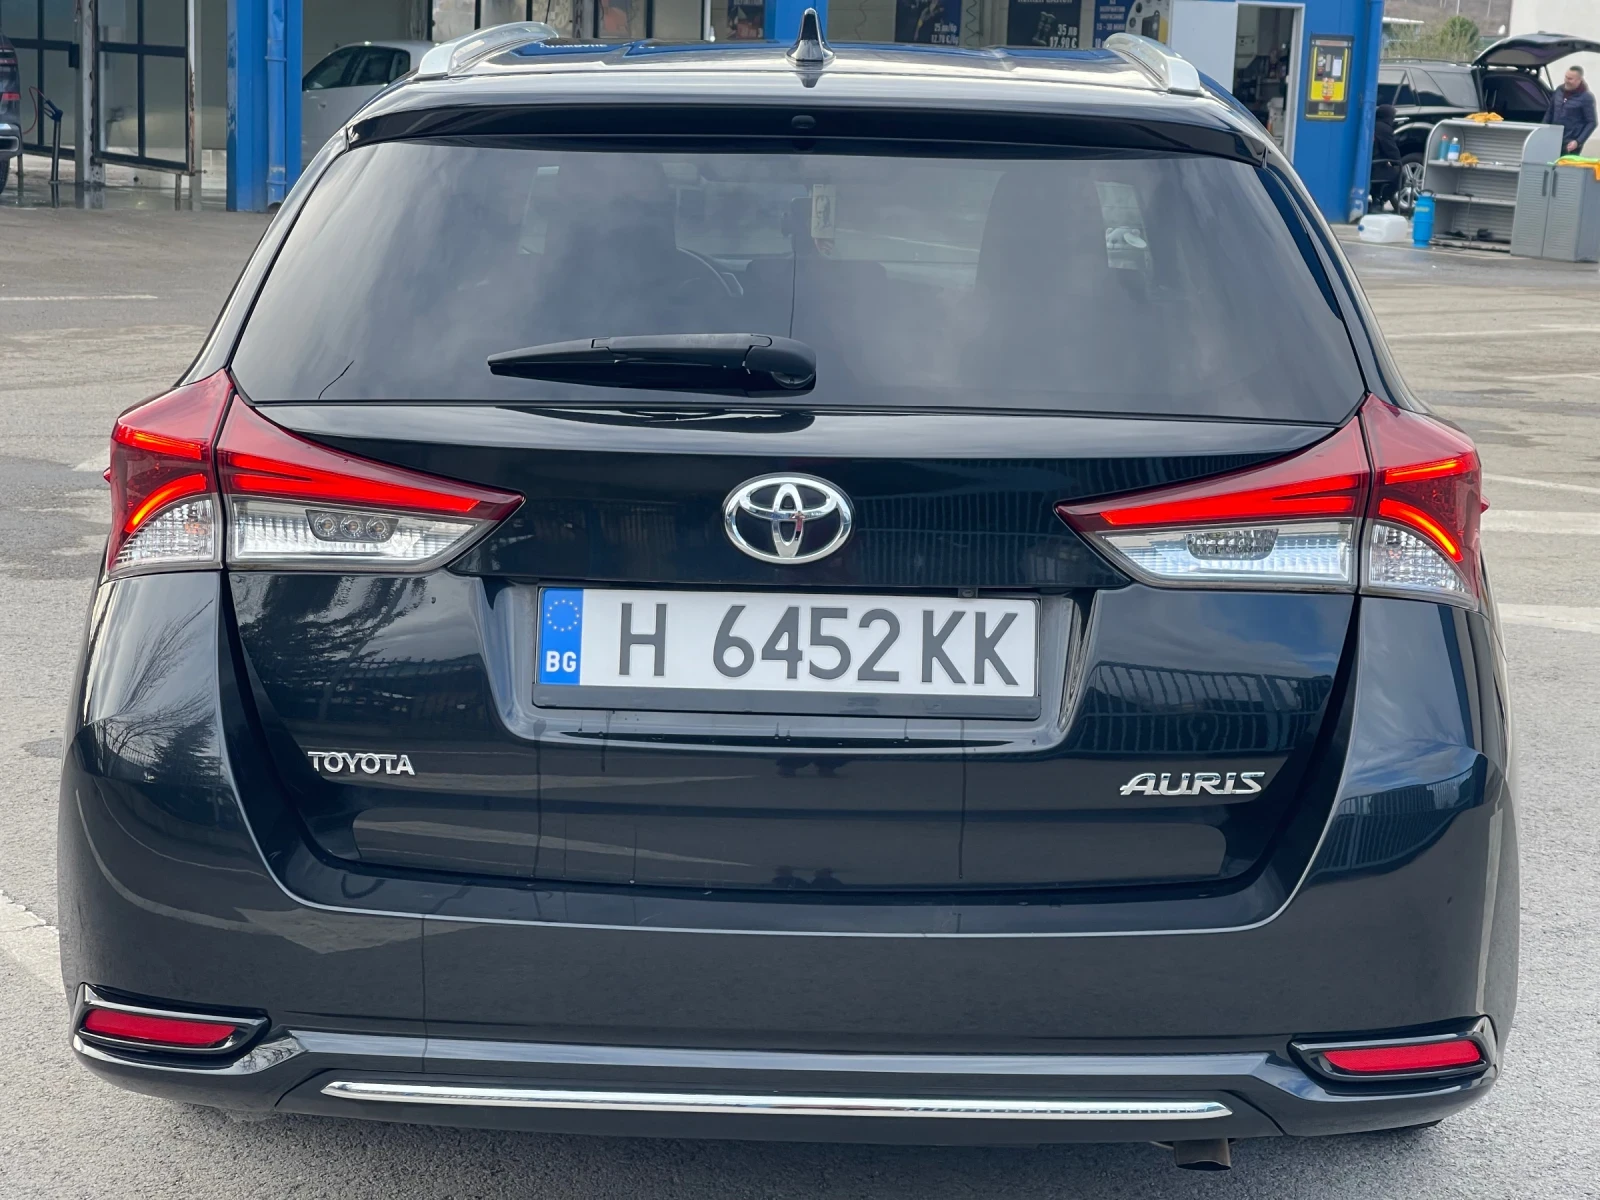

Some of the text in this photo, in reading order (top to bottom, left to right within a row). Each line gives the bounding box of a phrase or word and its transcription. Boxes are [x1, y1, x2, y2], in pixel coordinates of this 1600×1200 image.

[1057, 24, 1067, 36] 35
[1049, 36, 1071, 49] 17.90
[712, 605, 901, 682] 6452
[920, 609, 1019, 686] KK
[545, 650, 577, 673] BG
[307, 751, 416, 776] TOYOTA
[1119, 771, 1266, 796] AURIS
